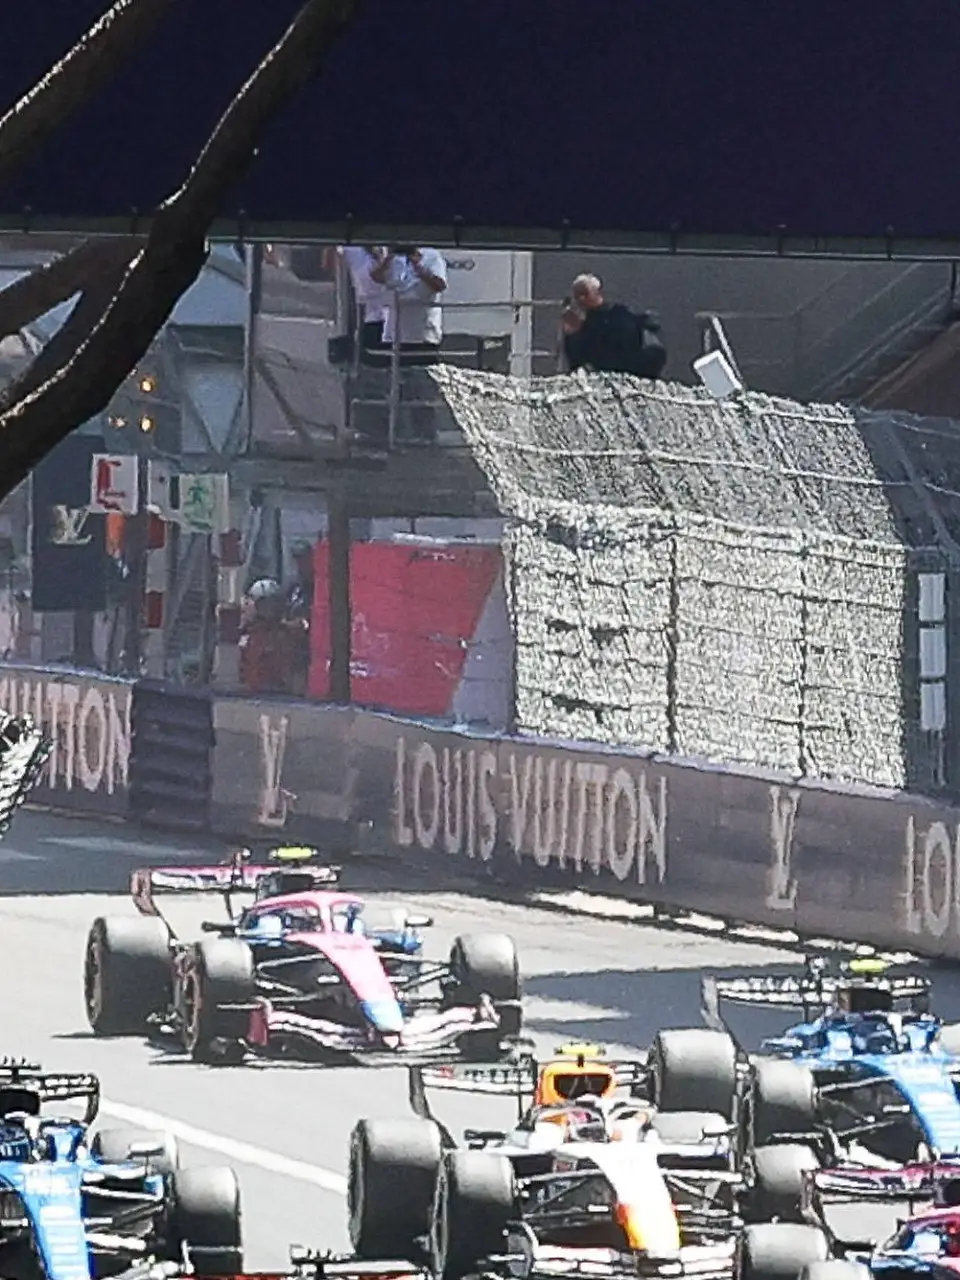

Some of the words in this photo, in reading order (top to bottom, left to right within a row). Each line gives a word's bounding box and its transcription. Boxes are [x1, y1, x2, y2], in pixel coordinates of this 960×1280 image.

[0, 677, 132, 795] ITTON
[395, 736, 498, 862] LOUIS
[509, 753, 668, 884] VUITTON
